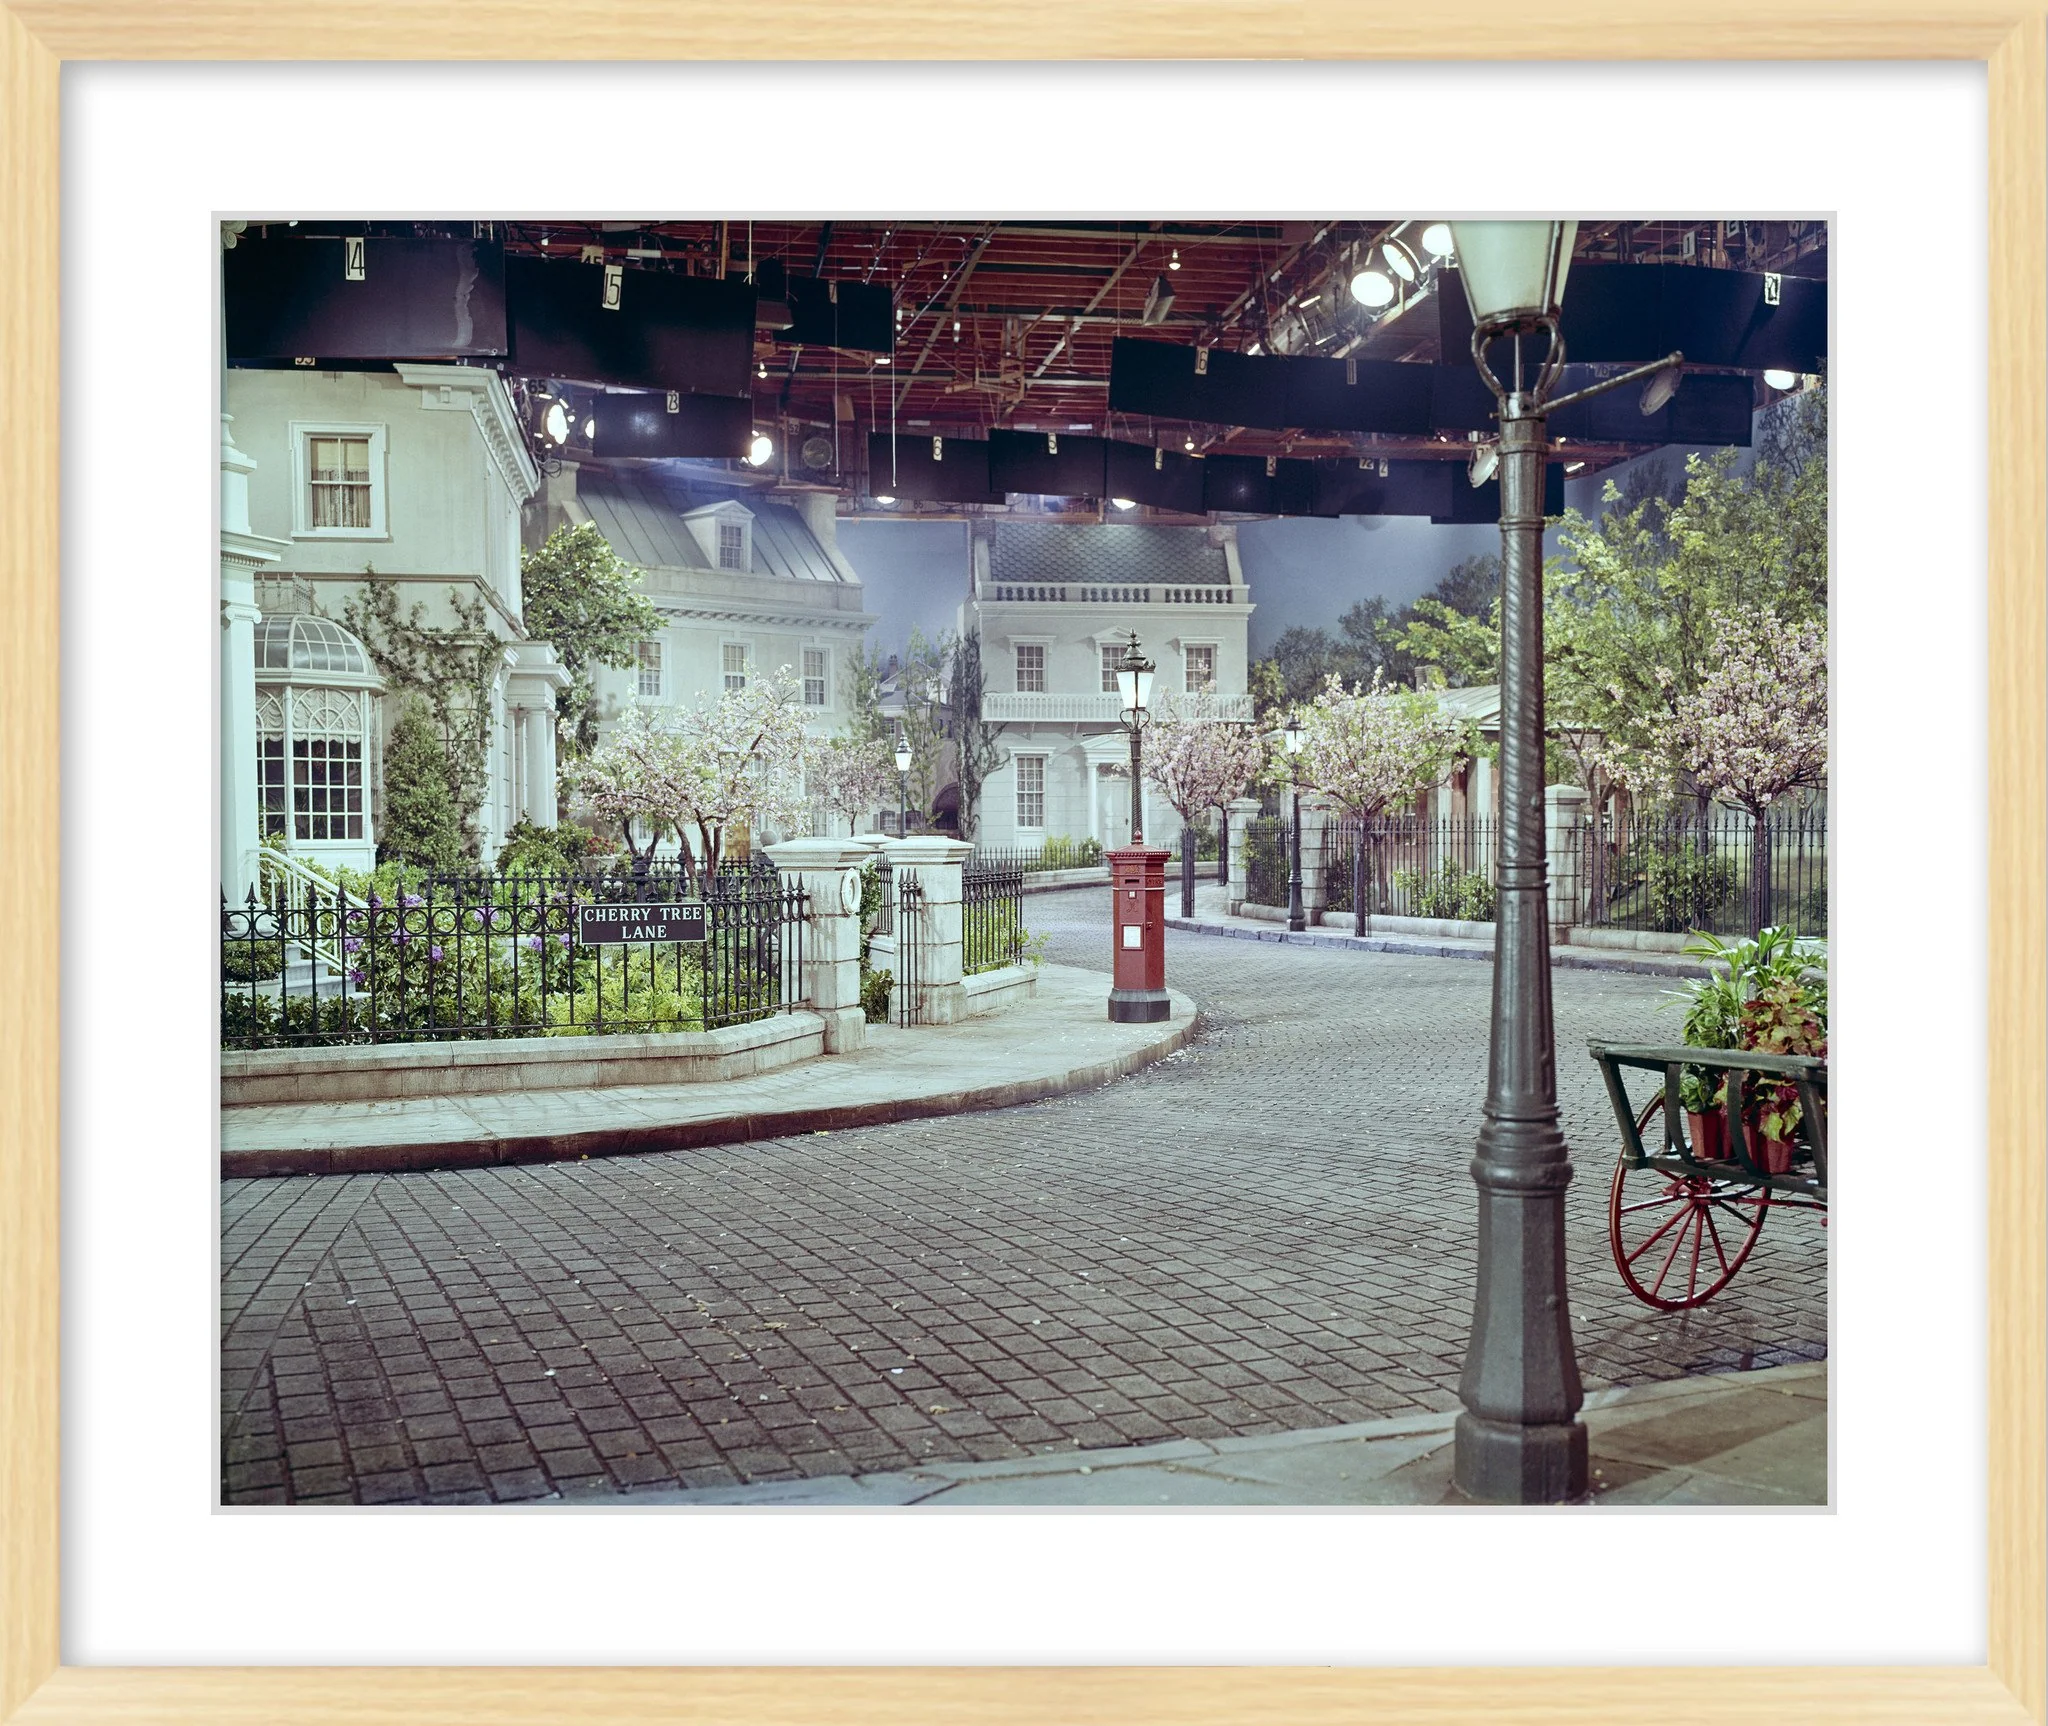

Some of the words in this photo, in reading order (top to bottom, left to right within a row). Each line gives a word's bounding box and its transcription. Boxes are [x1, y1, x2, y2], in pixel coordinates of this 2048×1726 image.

[345, 241, 364, 277] 14
[602, 272, 620, 306] 15
[527, 379, 547, 395] 65
[584, 907, 652, 922] CHERRY
[659, 907, 702, 921] TREE
[621, 925, 667, 939] LANE
